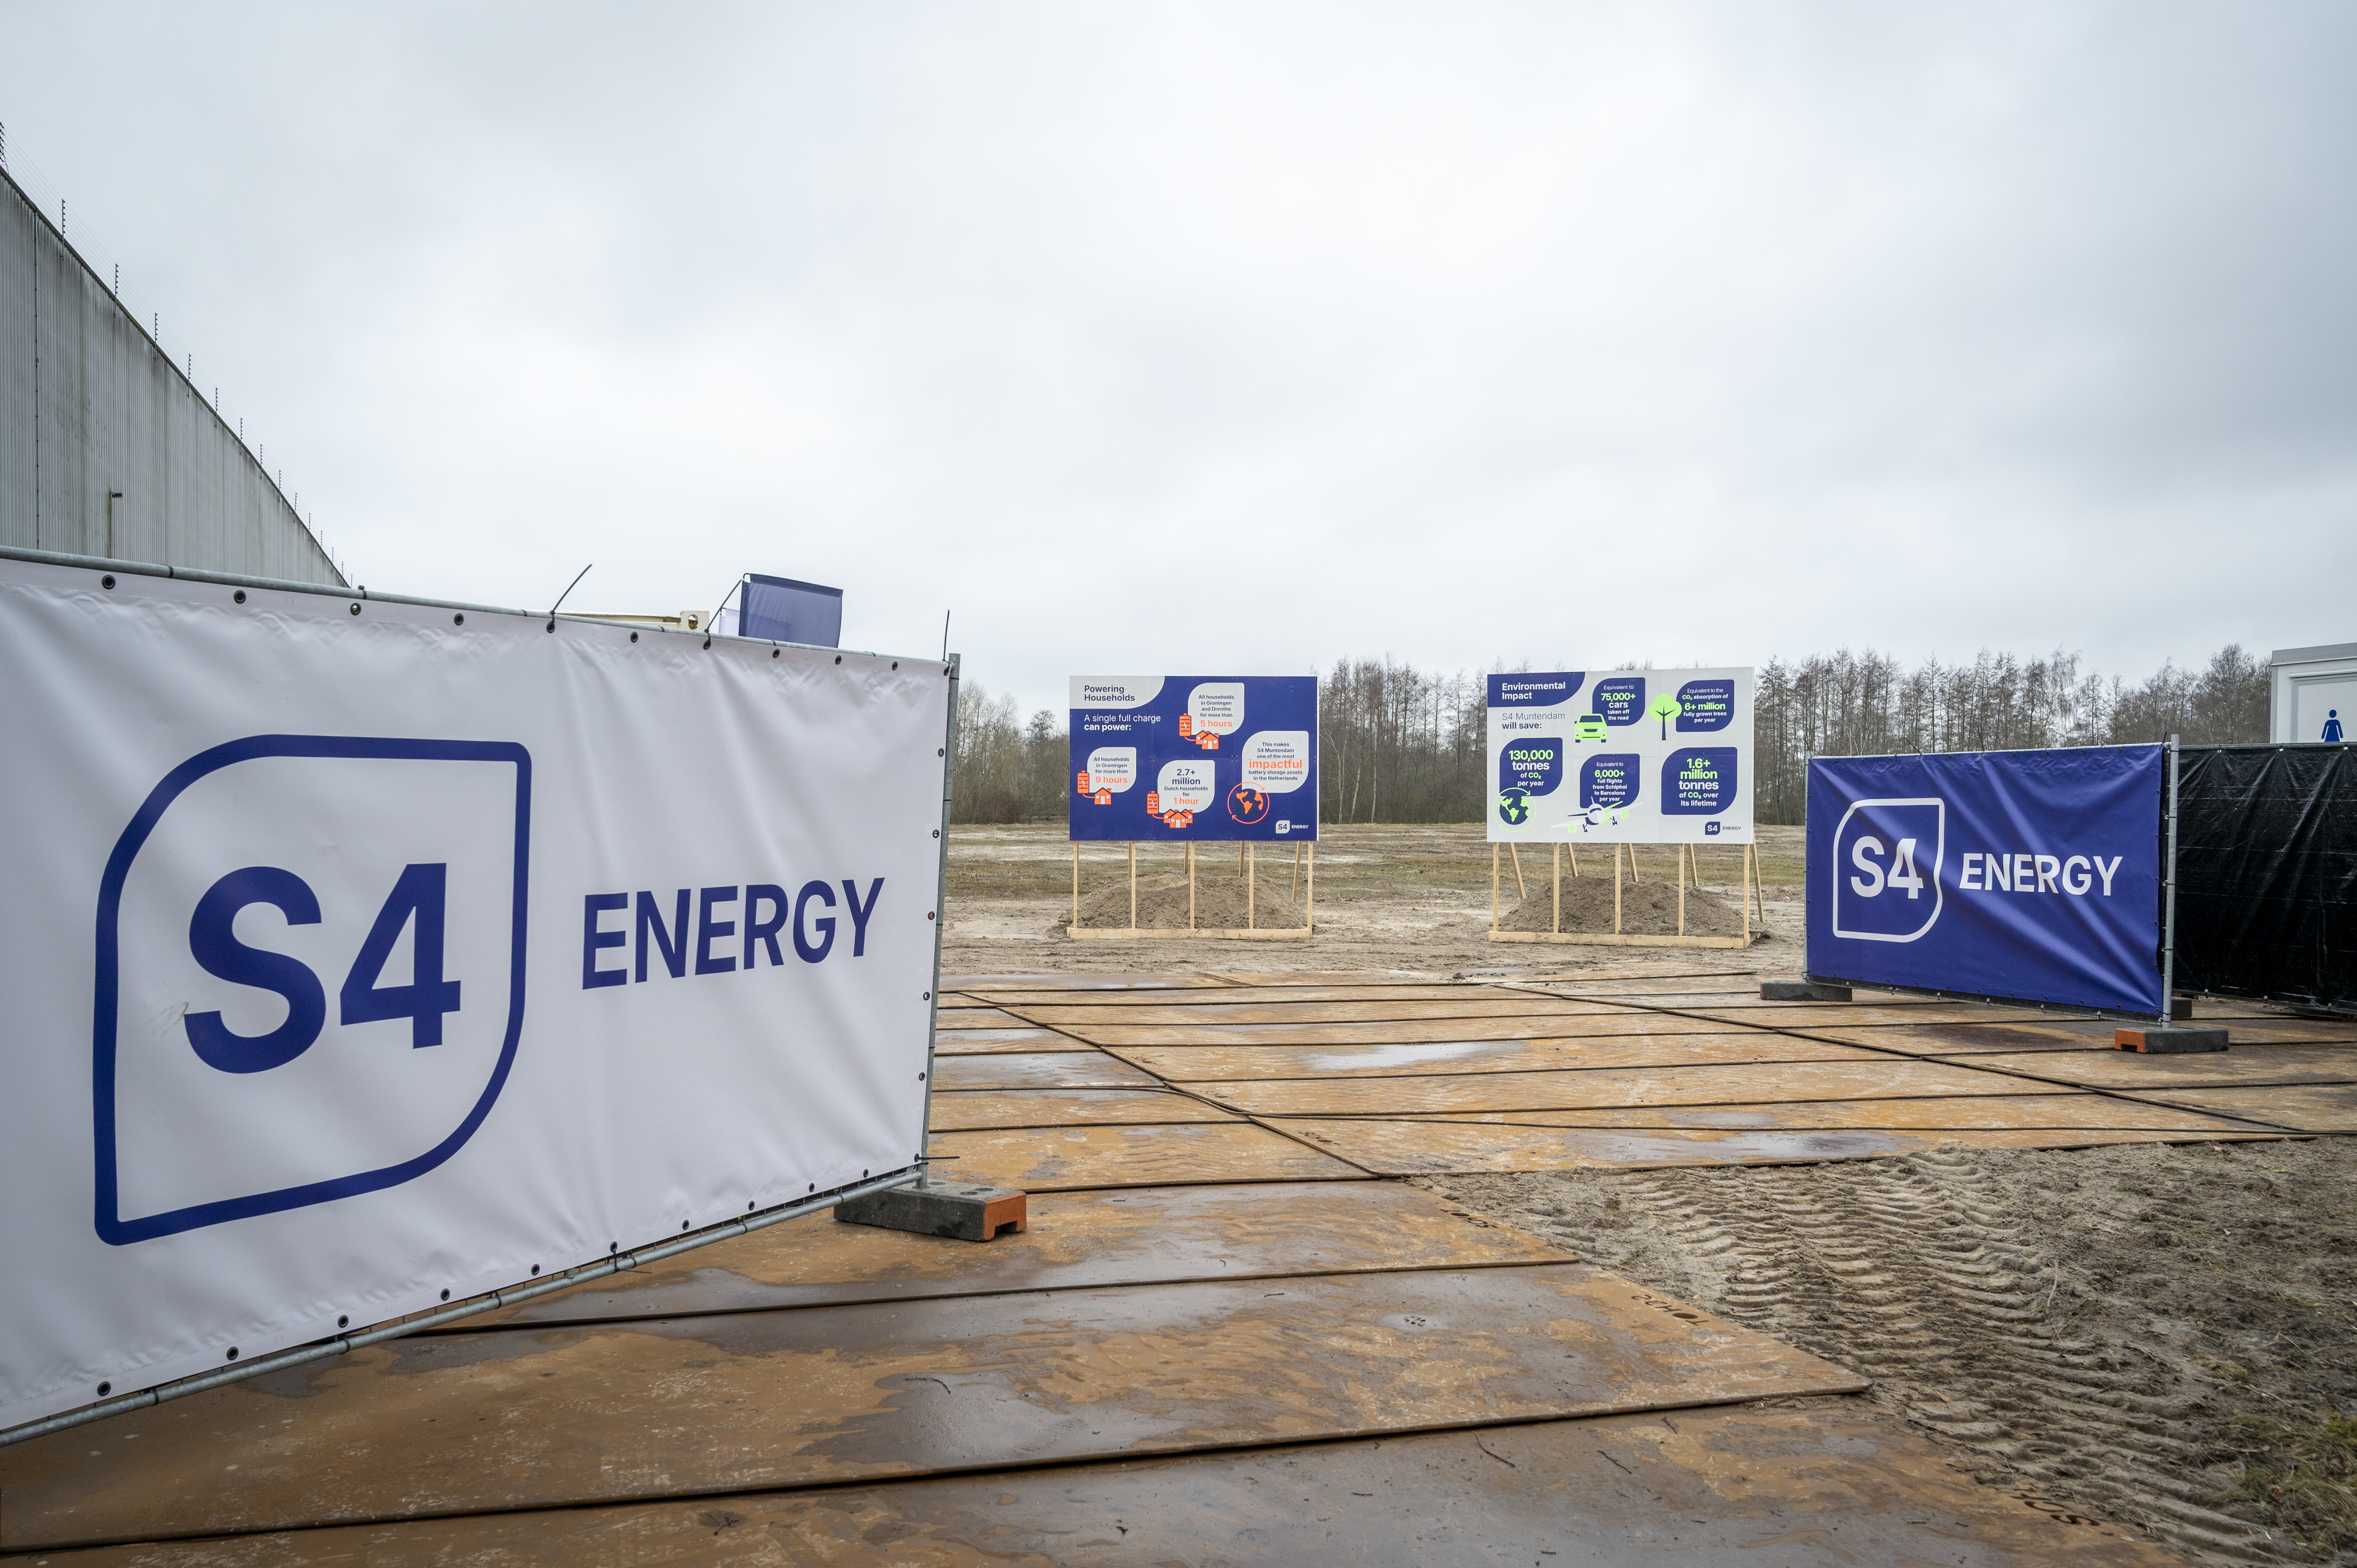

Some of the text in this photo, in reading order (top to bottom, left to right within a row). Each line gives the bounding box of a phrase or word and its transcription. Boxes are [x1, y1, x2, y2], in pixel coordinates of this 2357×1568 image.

[1085, 685, 1124, 694] Powering
[1503, 682, 1565, 690] Environmental
[1502, 692, 1532, 701] Impact
[1601, 693, 1636, 702] 75,000+
[1698, 702, 1725, 710] million
[1093, 714, 1116, 723] single
[1133, 714, 1161, 723] charge
[1509, 750, 1553, 762] 130,000
[1249, 759, 1302, 770] impactful
[1512, 761, 1549, 770] tonnes
[1687, 758, 1710, 768] 1.6+
[1595, 770, 1625, 779] 6,000+
[1680, 769, 1717, 779] million
[1679, 781, 1719, 790] tonnes
[1851, 836, 2123, 899] S4 ENERGY
[184, 863, 885, 1074] S4 ENERGY
